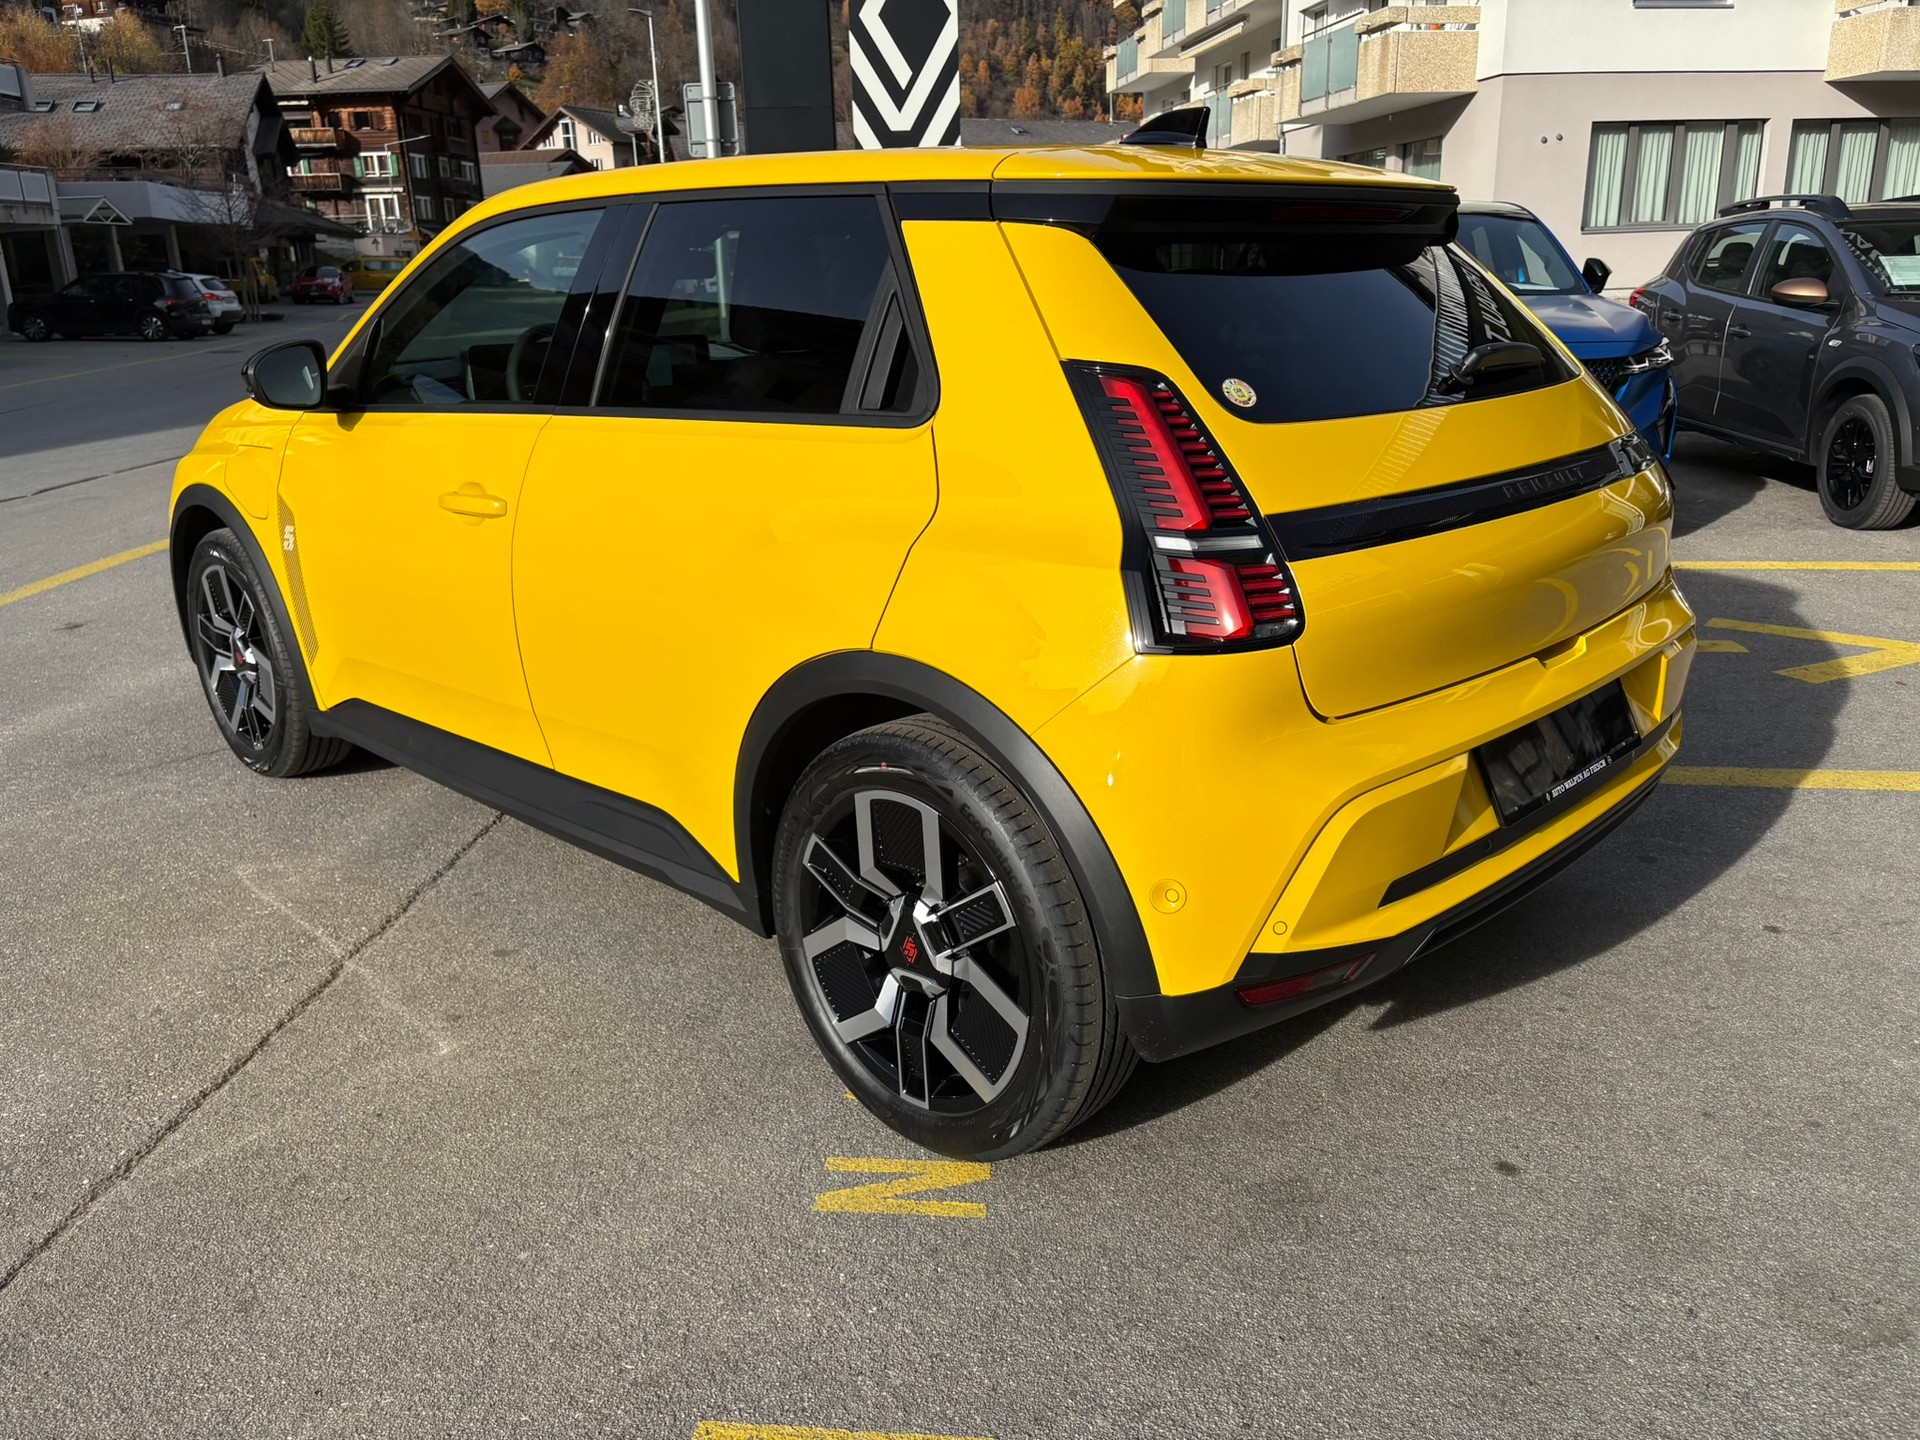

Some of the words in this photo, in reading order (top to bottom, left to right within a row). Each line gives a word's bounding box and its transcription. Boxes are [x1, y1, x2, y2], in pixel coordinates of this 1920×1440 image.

[1502, 467, 1584, 498] RENAULT
[1551, 784, 1565, 798] AUTO
[1564, 772, 1584, 789] WALPEN
[1583, 769, 1591, 779] AG
[1590, 759, 1606, 775] FIESCH
